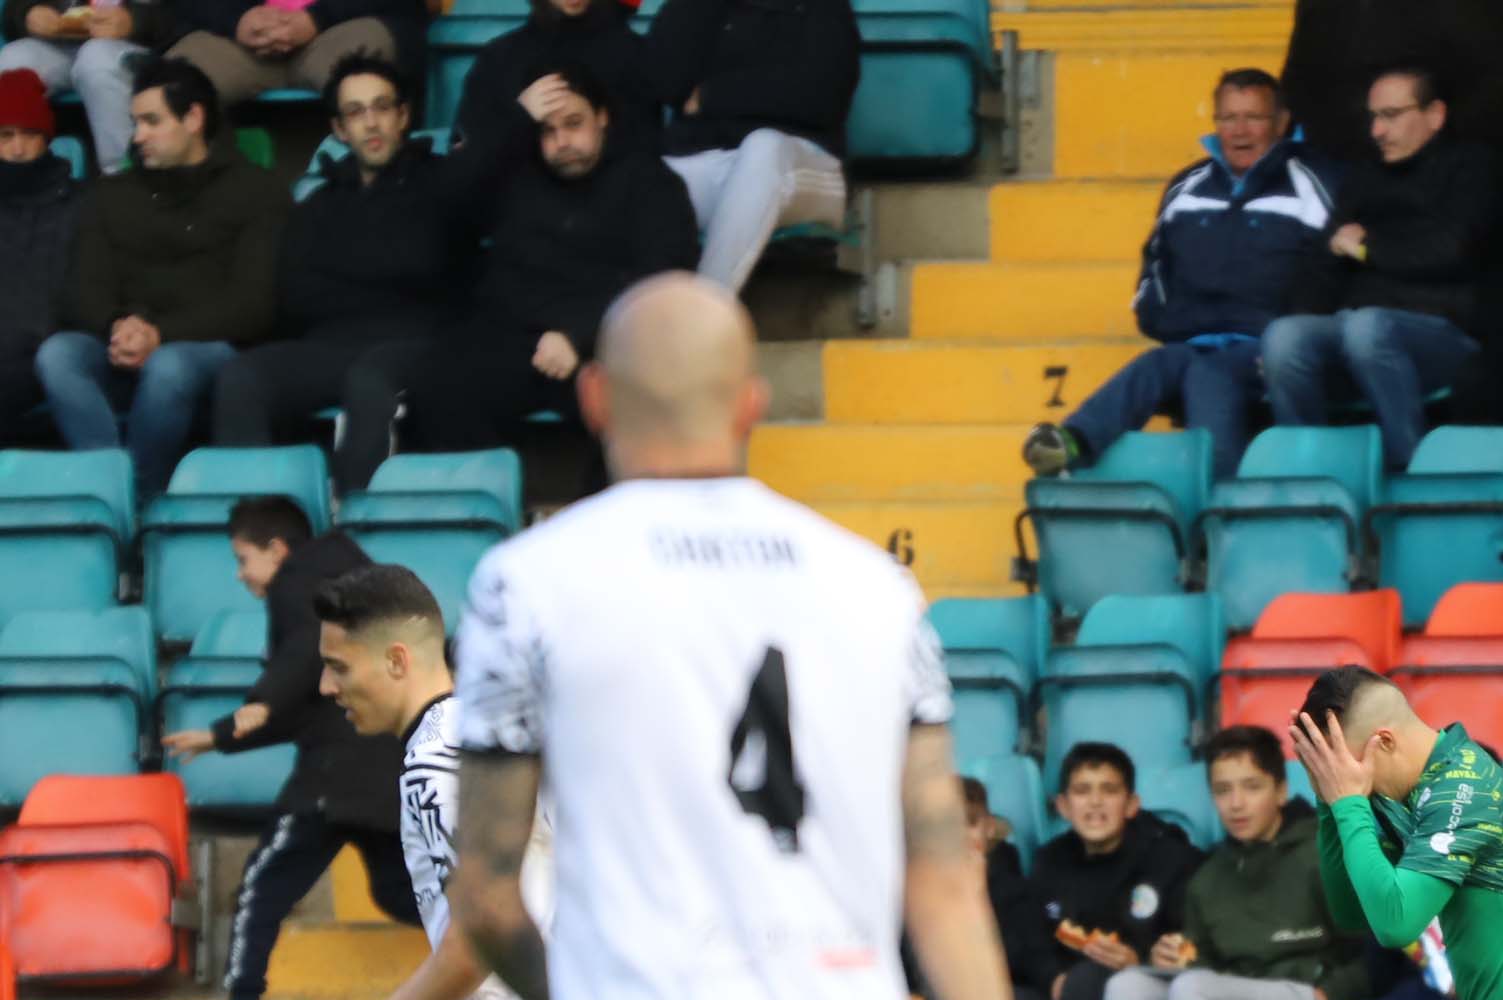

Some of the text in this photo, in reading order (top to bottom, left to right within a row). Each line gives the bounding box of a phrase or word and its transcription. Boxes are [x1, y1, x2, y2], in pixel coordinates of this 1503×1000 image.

[1043, 364, 1069, 408] 7
[887, 527, 916, 567] 6
[727, 645, 806, 855] 4
